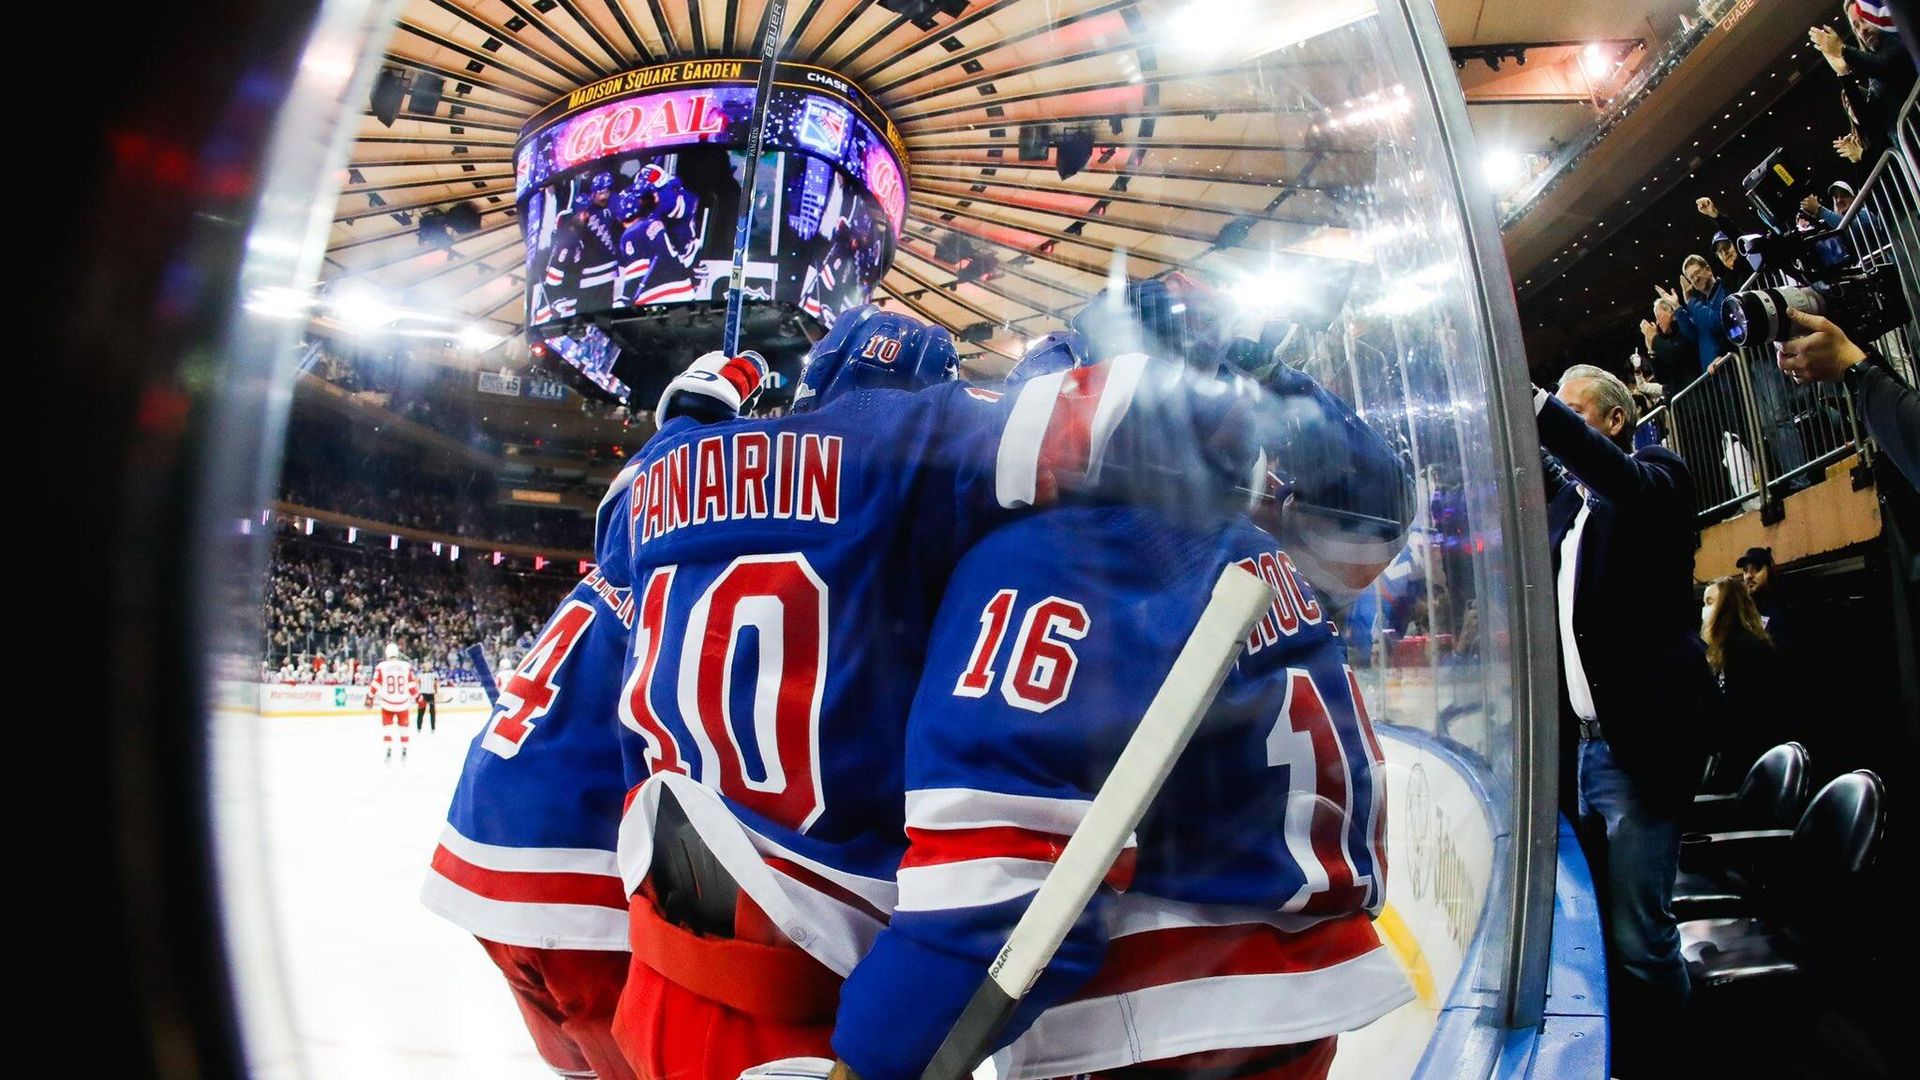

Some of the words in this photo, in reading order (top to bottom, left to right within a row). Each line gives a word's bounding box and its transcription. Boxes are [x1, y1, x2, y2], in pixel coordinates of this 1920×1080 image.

[1722, 0, 1755, 31] CHASE
[567, 77, 623, 110] MADISON
[625, 66, 680, 90] SQUARE
[682, 62, 742, 81] GARDEN
[807, 71, 849, 93] CHASE
[564, 95, 724, 161] GOAL
[861, 335, 902, 364] 10
[630, 431, 843, 557] PANARIN
[480, 599, 597, 760] 4
[952, 588, 1092, 713] 16
[618, 551, 829, 835] 10
